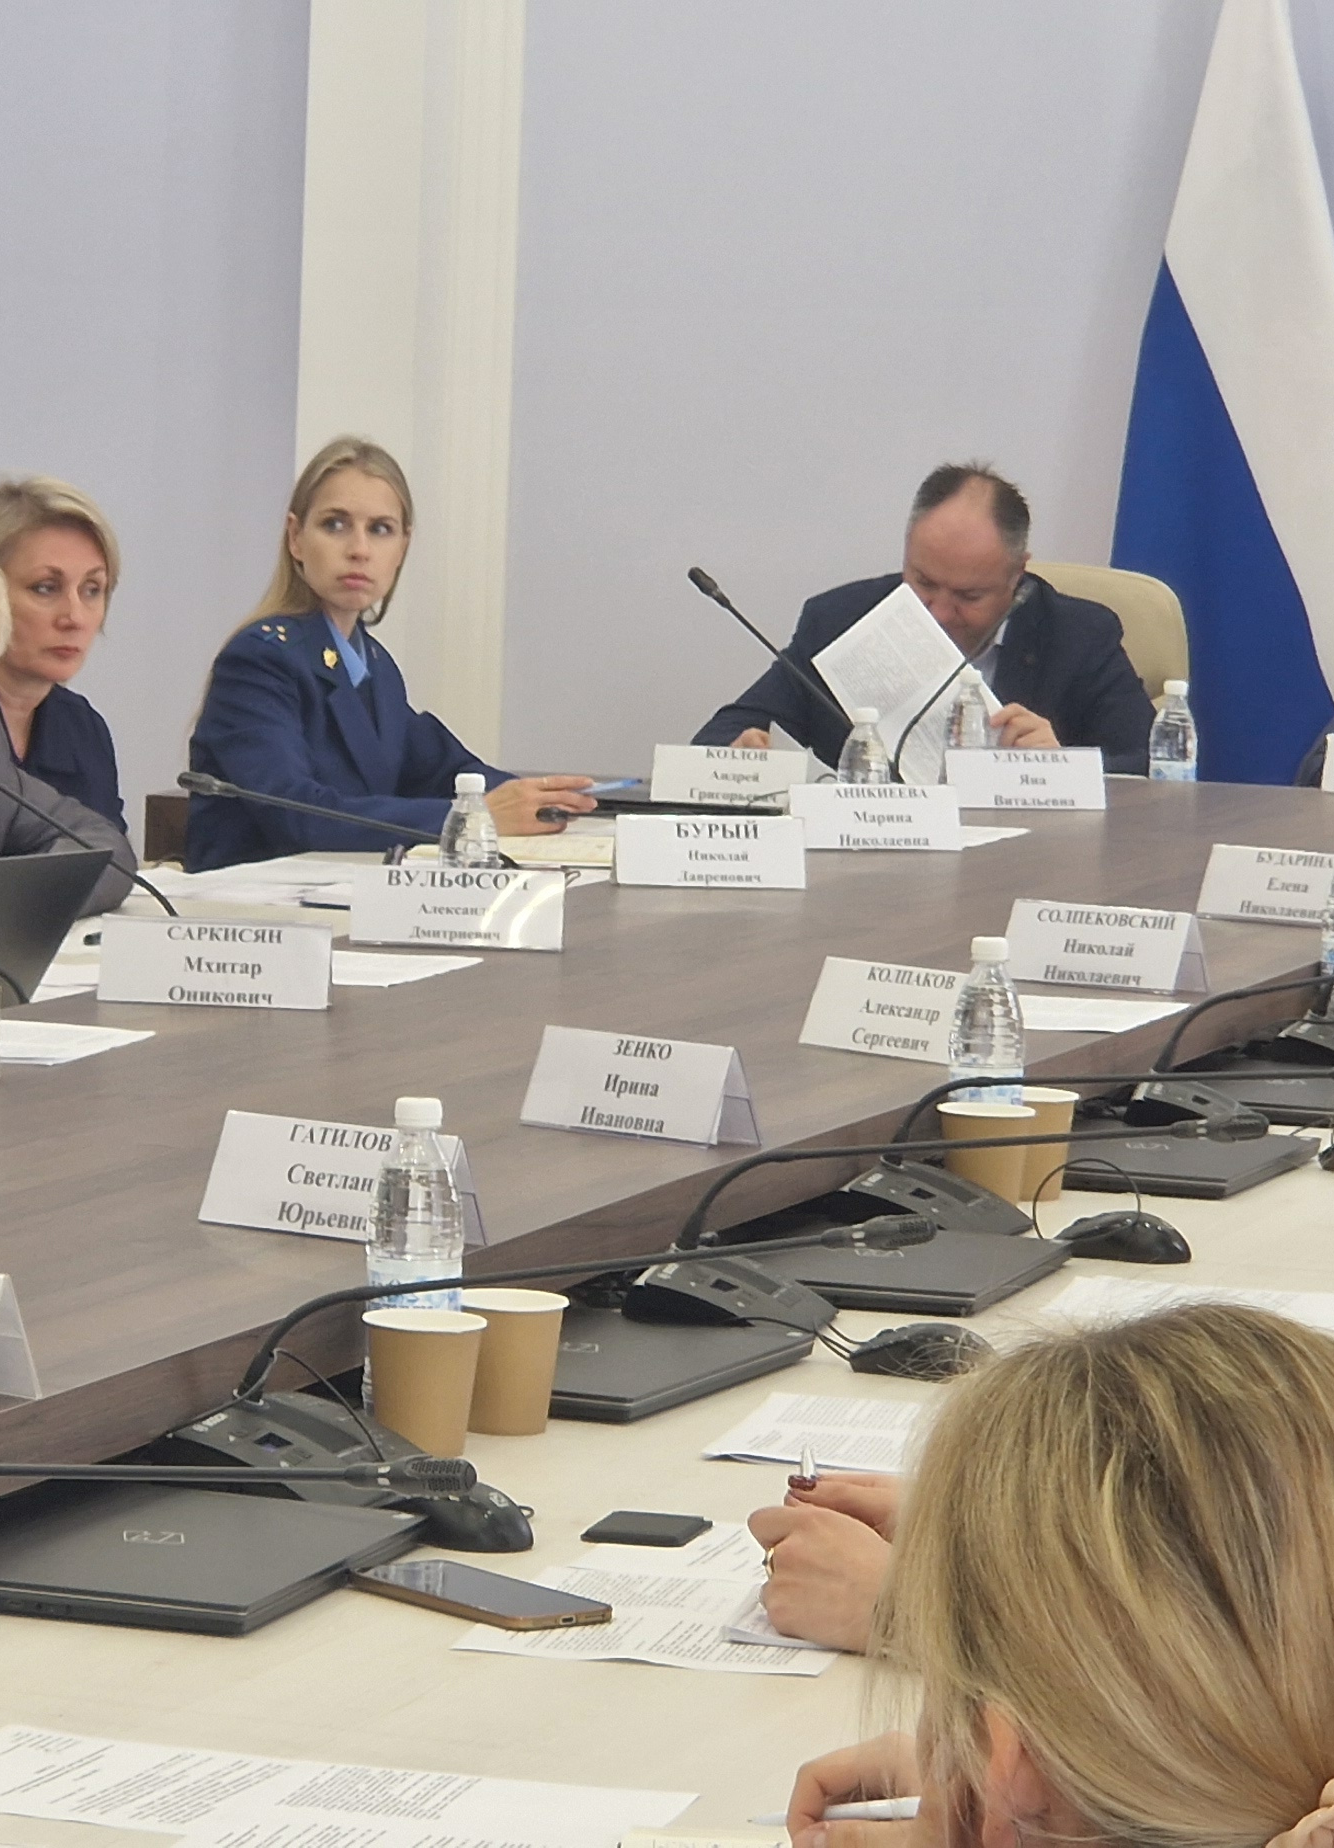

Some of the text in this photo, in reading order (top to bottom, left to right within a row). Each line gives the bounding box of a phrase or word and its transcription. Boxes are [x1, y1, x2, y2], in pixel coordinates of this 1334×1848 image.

[712, 770, 760, 784] Андрей
[1020, 774, 1047, 785] Яна
[994, 795, 1075, 807] Витальевна
[854, 811, 912, 826] Марина
[675, 820, 760, 839] БУРЫЙ
[839, 834, 929, 847] Николаевна
[688, 850, 749, 862] Николай
[1256, 851, 1334, 869] БУДАРИНА
[677, 870, 761, 885] Лавренович
[1267, 877, 1309, 893] Елена
[1037, 908, 1177, 931] СОЛПЕКОВСКИЙ
[167, 926, 282, 944] САРКИСЯН
[409, 926, 500, 941] Дмитриевич
[1063, 938, 1136, 957] Николай
[184, 956, 262, 979] Мхитар
[1044, 964, 1142, 986] Николаевич
[867, 966, 957, 990] КОЛПАКОВ
[168, 985, 273, 1005] Оникович
[859, 999, 940, 1025] Александр
[851, 1027, 930, 1052] Сергеевич
[612, 1039, 672, 1060] ЗЕНКО
[603, 1073, 660, 1099] Ирина
[579, 1106, 665, 1134] Ивановна
[289, 1124, 393, 1152] ГАТИЛОВ
[287, 1163, 373, 1193] Светлан
